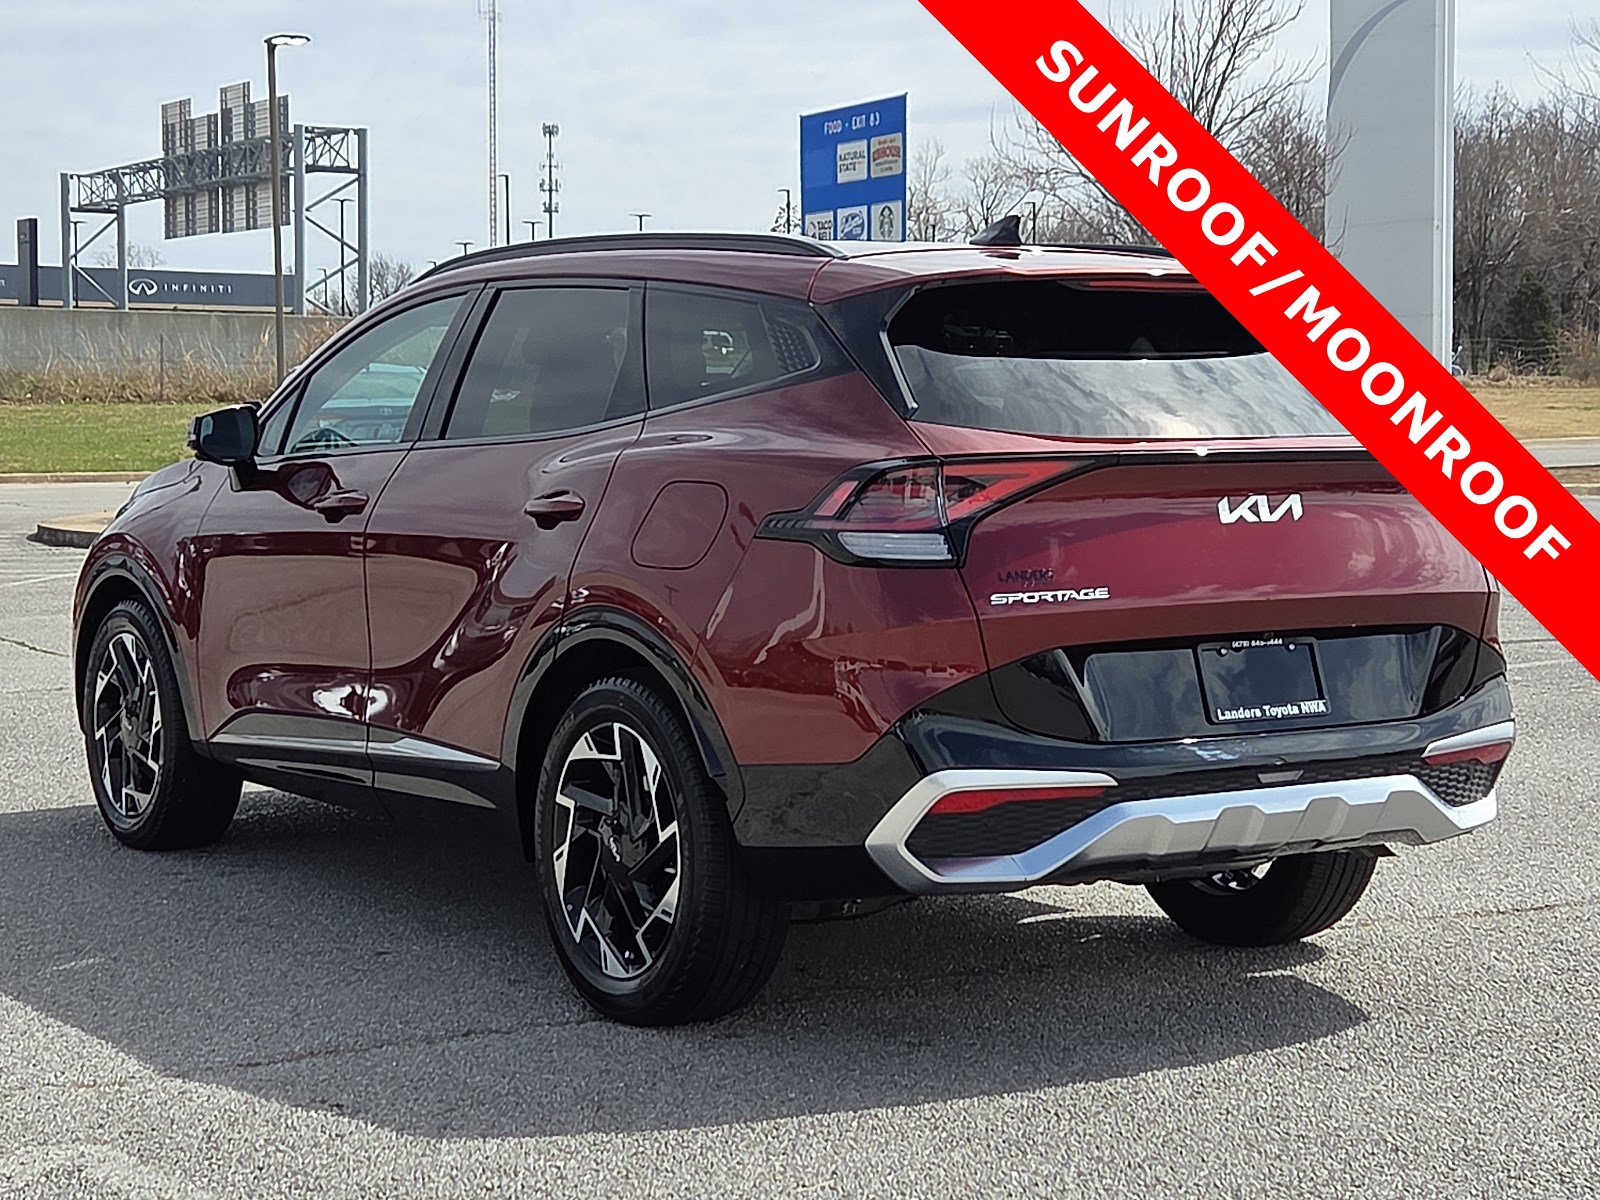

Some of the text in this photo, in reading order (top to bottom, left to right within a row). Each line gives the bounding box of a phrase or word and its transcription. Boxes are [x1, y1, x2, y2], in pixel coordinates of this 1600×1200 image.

[824, 119, 842, 134] FOOD
[839, 149, 866, 162] NATURAL
[839, 161, 857, 173] STATE
[163, 284, 232, 294] INFINITI
[1217, 493, 1304, 524] KIA
[990, 587, 1110, 605] SPORTAGE
[1217, 700, 1327, 720] Landers Toyota NWA
